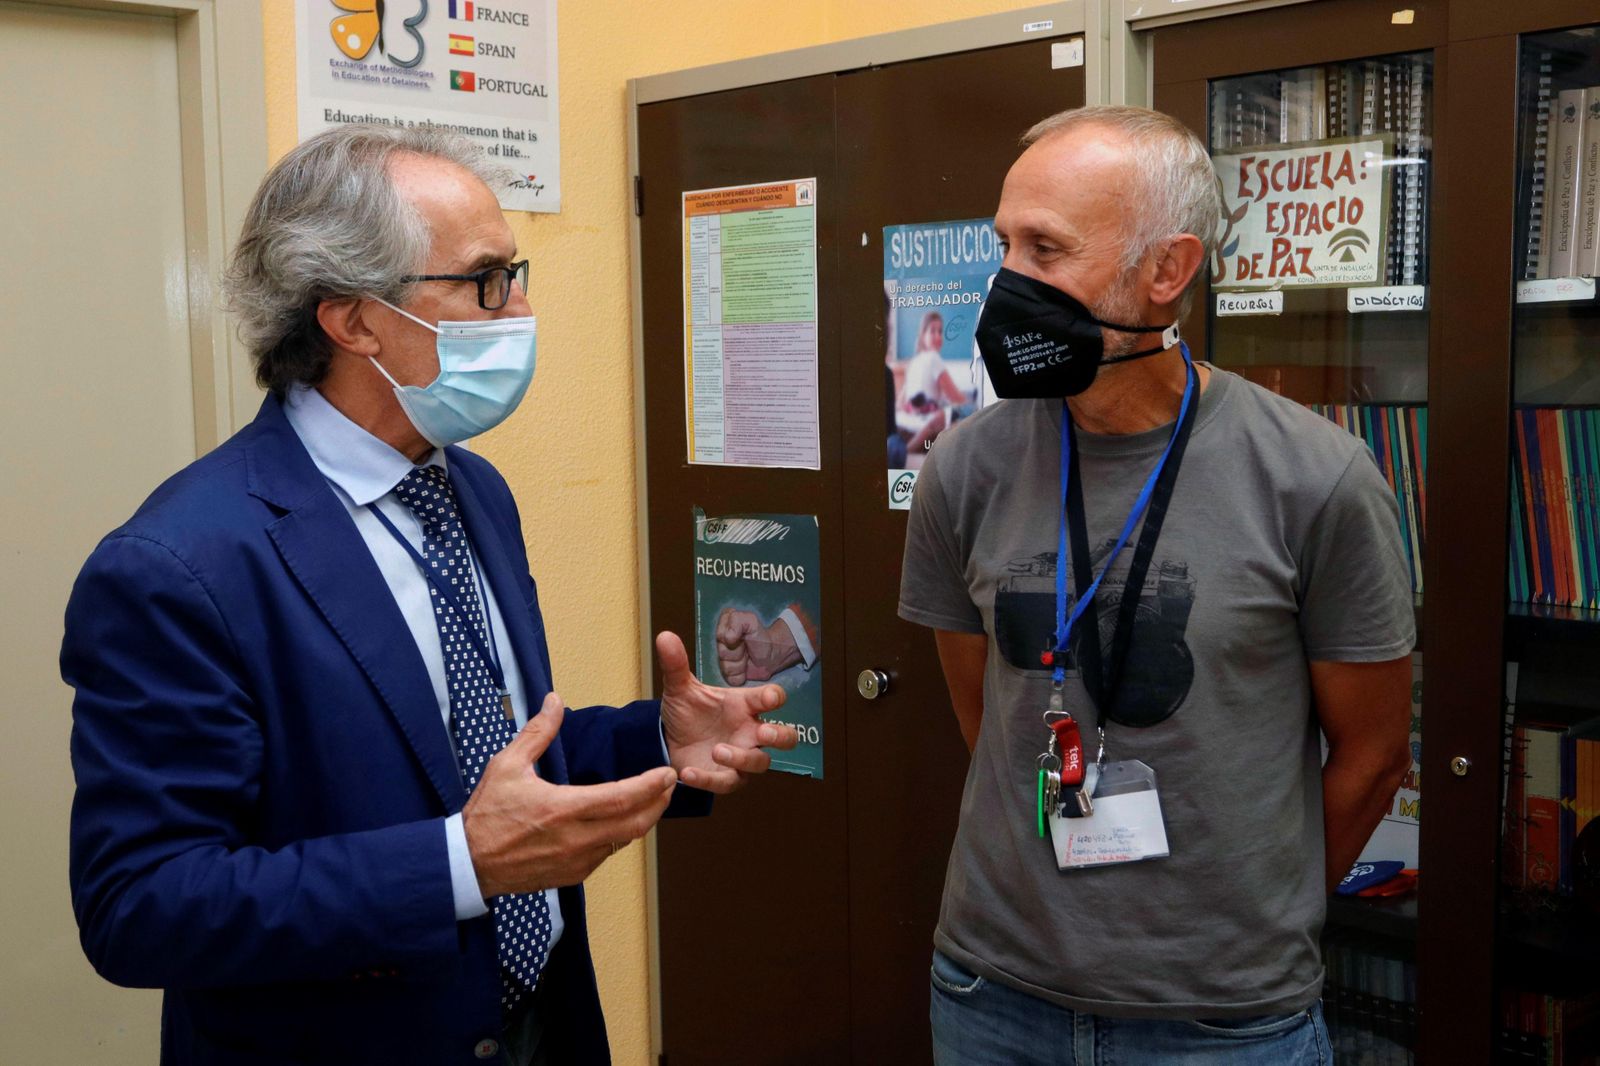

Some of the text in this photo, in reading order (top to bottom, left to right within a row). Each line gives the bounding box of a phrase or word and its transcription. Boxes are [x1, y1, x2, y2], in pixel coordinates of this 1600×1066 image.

[477, 7, 529, 27] FRANCE
[478, 42, 516, 59] SPAIN
[329, 58, 368, 71] Exchange
[380, 65, 434, 78] Methodologies
[342, 71, 381, 83] Education
[478, 77, 548, 98] PORTUGAL
[324, 108, 390, 125] Education
[394, 116, 404, 127] is
[502, 127, 525, 141] that
[528, 129, 538, 142] is
[487, 143, 499, 156] of
[502, 144, 530, 159] life...
[1237, 149, 1367, 203] ESCUELA:
[1562, 200, 1570, 209] de
[1587, 197, 1595, 205] de
[1266, 196, 1364, 237] ESPACIO
[1558, 209, 1571, 252] Enciclopedia
[1584, 207, 1596, 250] Enciclopedia
[1236, 237, 1316, 281] DE PAZ
[1340, 262, 1374, 272] ANDALUCÍA
[889, 279, 962, 294] Un derecho del
[889, 292, 982, 308] TRABAJADOR
[1219, 298, 1274, 311] RECURSOS
[1354, 291, 1423, 308] DIDÁCTICOS
[1012, 362, 1037, 376] FFP2
[697, 557, 805, 584] RECUPEREMOS
[1069, 744, 1079, 771] telc
